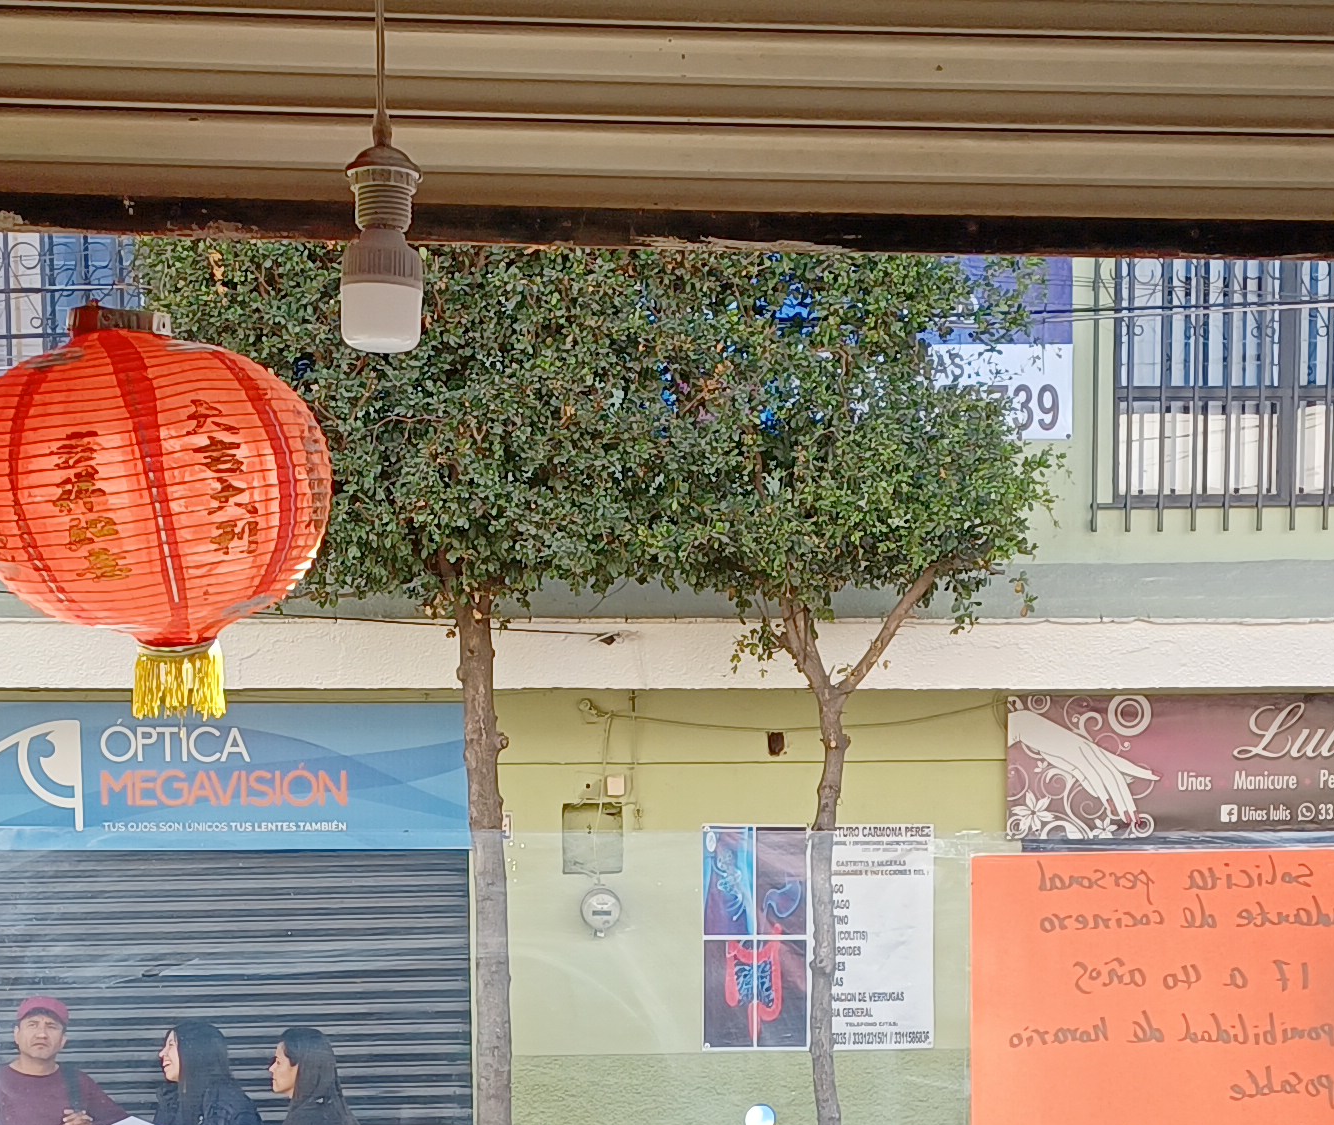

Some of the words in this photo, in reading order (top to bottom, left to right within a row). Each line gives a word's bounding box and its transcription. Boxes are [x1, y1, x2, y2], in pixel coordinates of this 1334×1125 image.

[100, 719, 251, 763] ÓPTICA
[100, 762, 349, 807] MEGAVISIÓN
[1177, 770, 1212, 792] Uñas
[1233, 769, 1298, 791] Manicure
[1241, 806, 1268, 822] Uñas
[1270, 803, 1292, 822] lulis
[103, 821, 126, 832] TUS
[128, 821, 157, 832] OJOS
[159, 821, 181, 832] SON
[185, 819, 228, 832] ÚNICOS
[230, 821, 252, 832] TUS
[254, 821, 297, 832] LENTES
[298, 818, 348, 832] TAMBIÉN
[862, 826, 903, 838] CARMONA
[837, 930, 869, 943] (COLITIS)
[857, 991, 868, 1002] DE
[868, 991, 905, 1002] VERRUGAS
[842, 1007, 873, 1018] GENERAL
